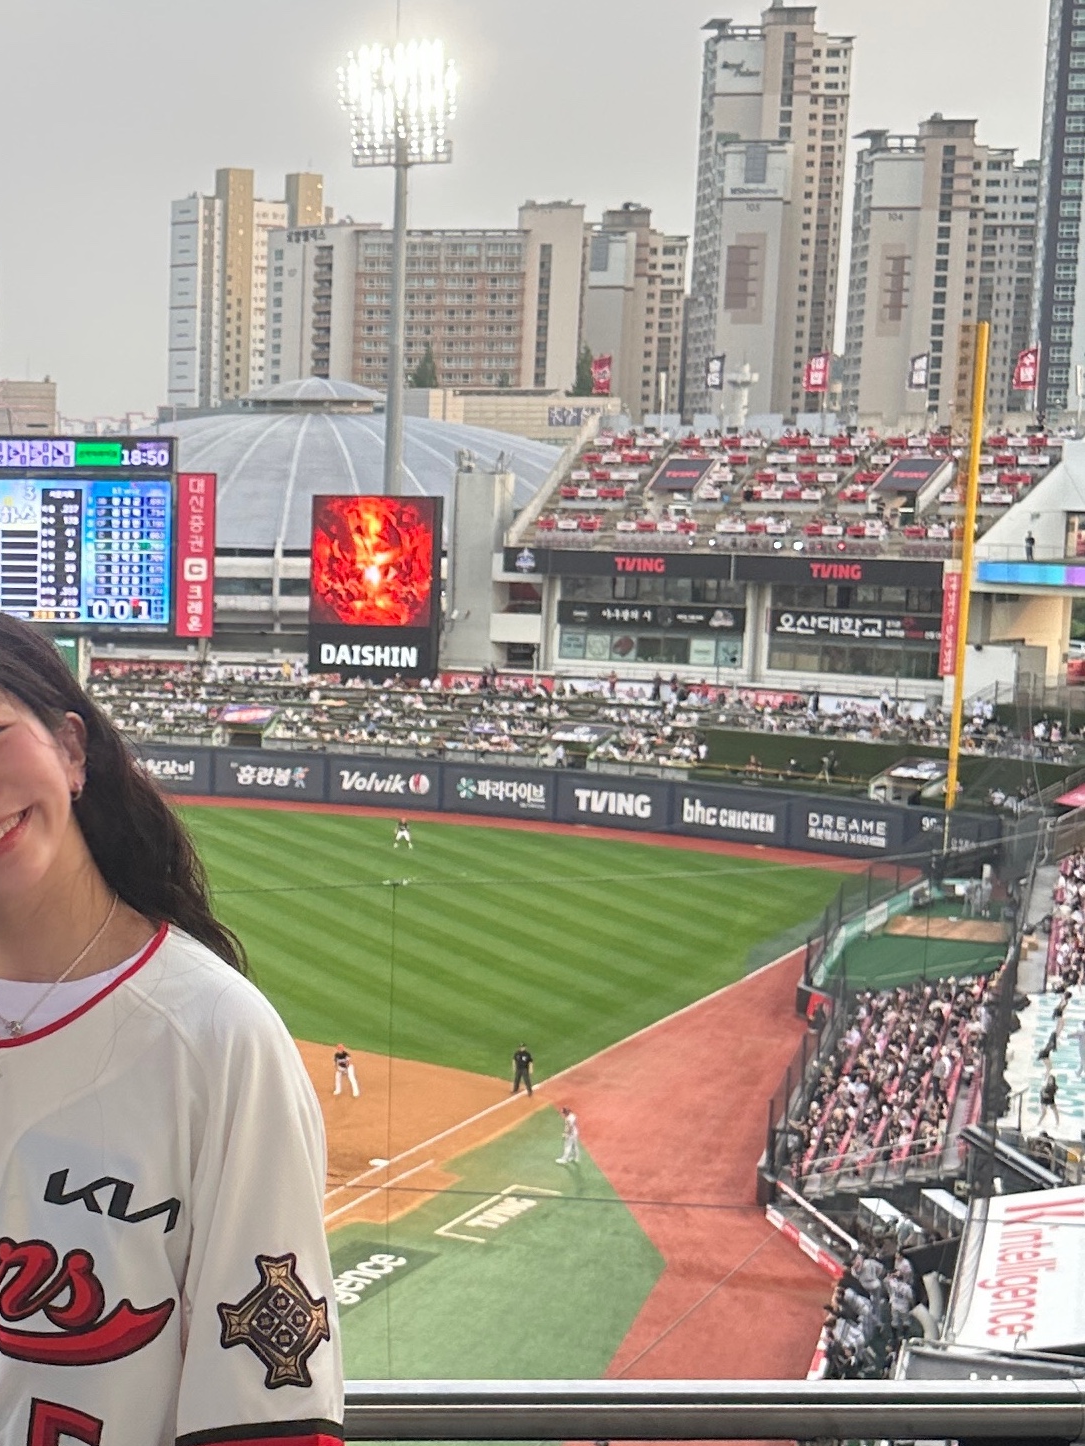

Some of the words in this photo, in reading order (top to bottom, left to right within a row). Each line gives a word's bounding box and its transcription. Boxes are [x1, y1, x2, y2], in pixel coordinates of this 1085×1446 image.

[121, 449, 170, 466] 18:50
[188, 478, 207, 553] 대신증권
[614, 556, 666, 573] TVING
[810, 563, 862, 580] TVING
[92, 600, 109, 620] 0
[113, 600, 131, 620] 0
[137, 601, 151, 620] 1
[776, 612, 883, 639] 오산대학교
[320, 643, 418, 668] DAISHIN
[339, 770, 408, 795] Volvik
[574, 788, 652, 819] TVING
[682, 797, 718, 826] bhc
[719, 807, 776, 833] CHICKEN
[807, 811, 887, 837] DREAME
[44, 1168, 181, 1234] KIA
[977, 1224, 1062, 1337] intelligence
